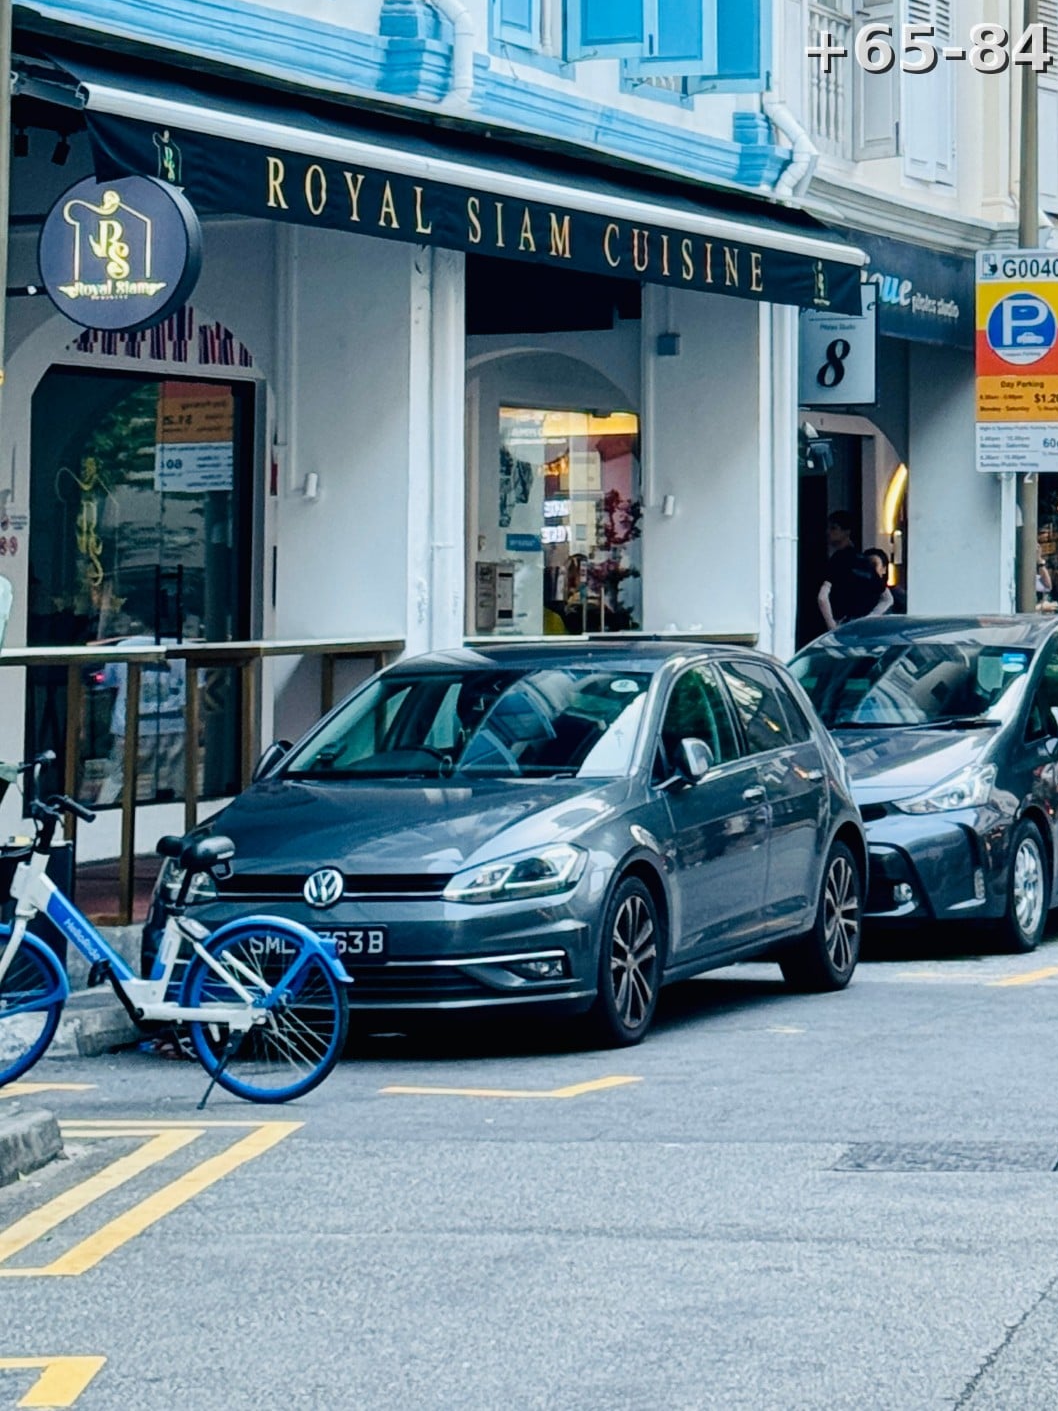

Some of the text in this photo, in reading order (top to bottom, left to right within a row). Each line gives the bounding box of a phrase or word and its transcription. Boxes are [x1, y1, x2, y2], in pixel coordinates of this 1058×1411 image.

[266, 156, 764, 292] ROYAL SIAM CUISINE
[73, 279, 112, 296] Royal
[816, 338, 851, 388] 8
